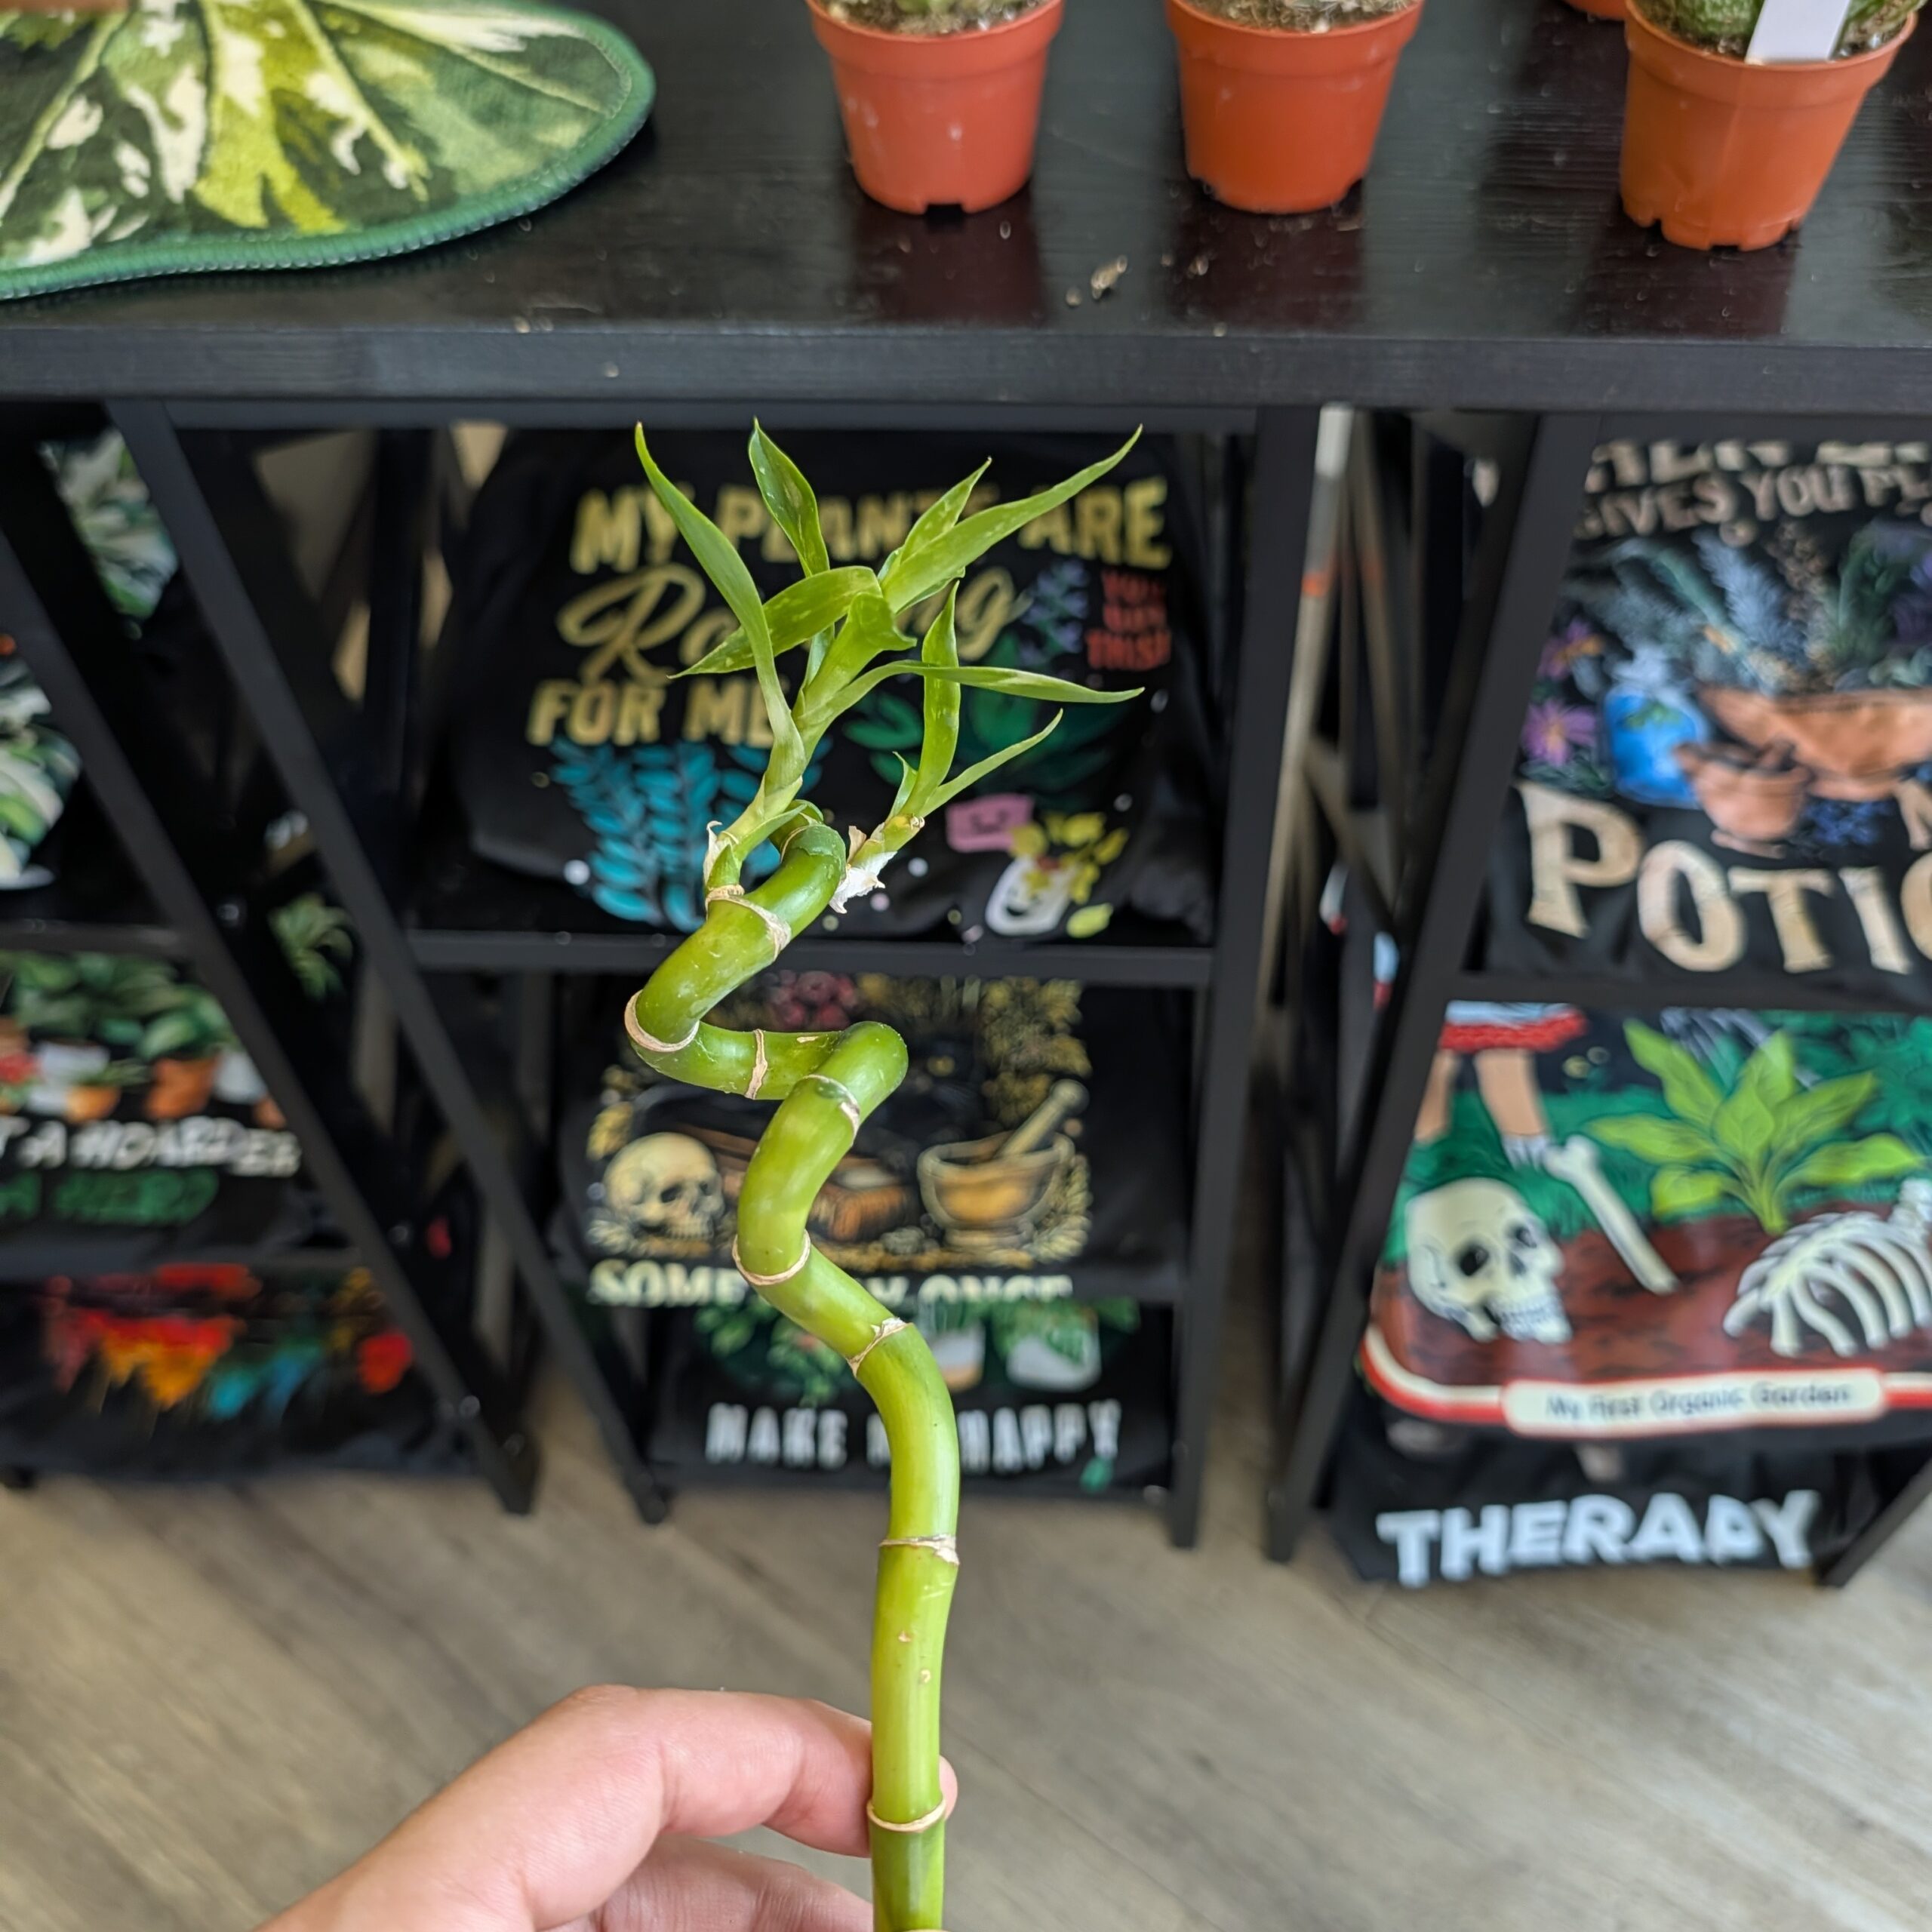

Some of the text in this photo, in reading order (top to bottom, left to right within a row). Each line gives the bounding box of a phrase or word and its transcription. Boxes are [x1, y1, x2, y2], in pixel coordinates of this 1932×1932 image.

[571, 477, 1172, 574] MY PLAN ARE
[1741, 462, 1855, 521] YOU
[526, 678, 667, 747] FOR
[704, 1401, 848, 1470] MAKE
[957, 1398, 1122, 1475] HAPPY
[1546, 1394, 1581, 1421] My
[1650, 1387, 1743, 1417] Organic
[1751, 1380, 1850, 1407] Garden
[1377, 1489, 1817, 1588] THERAPY
